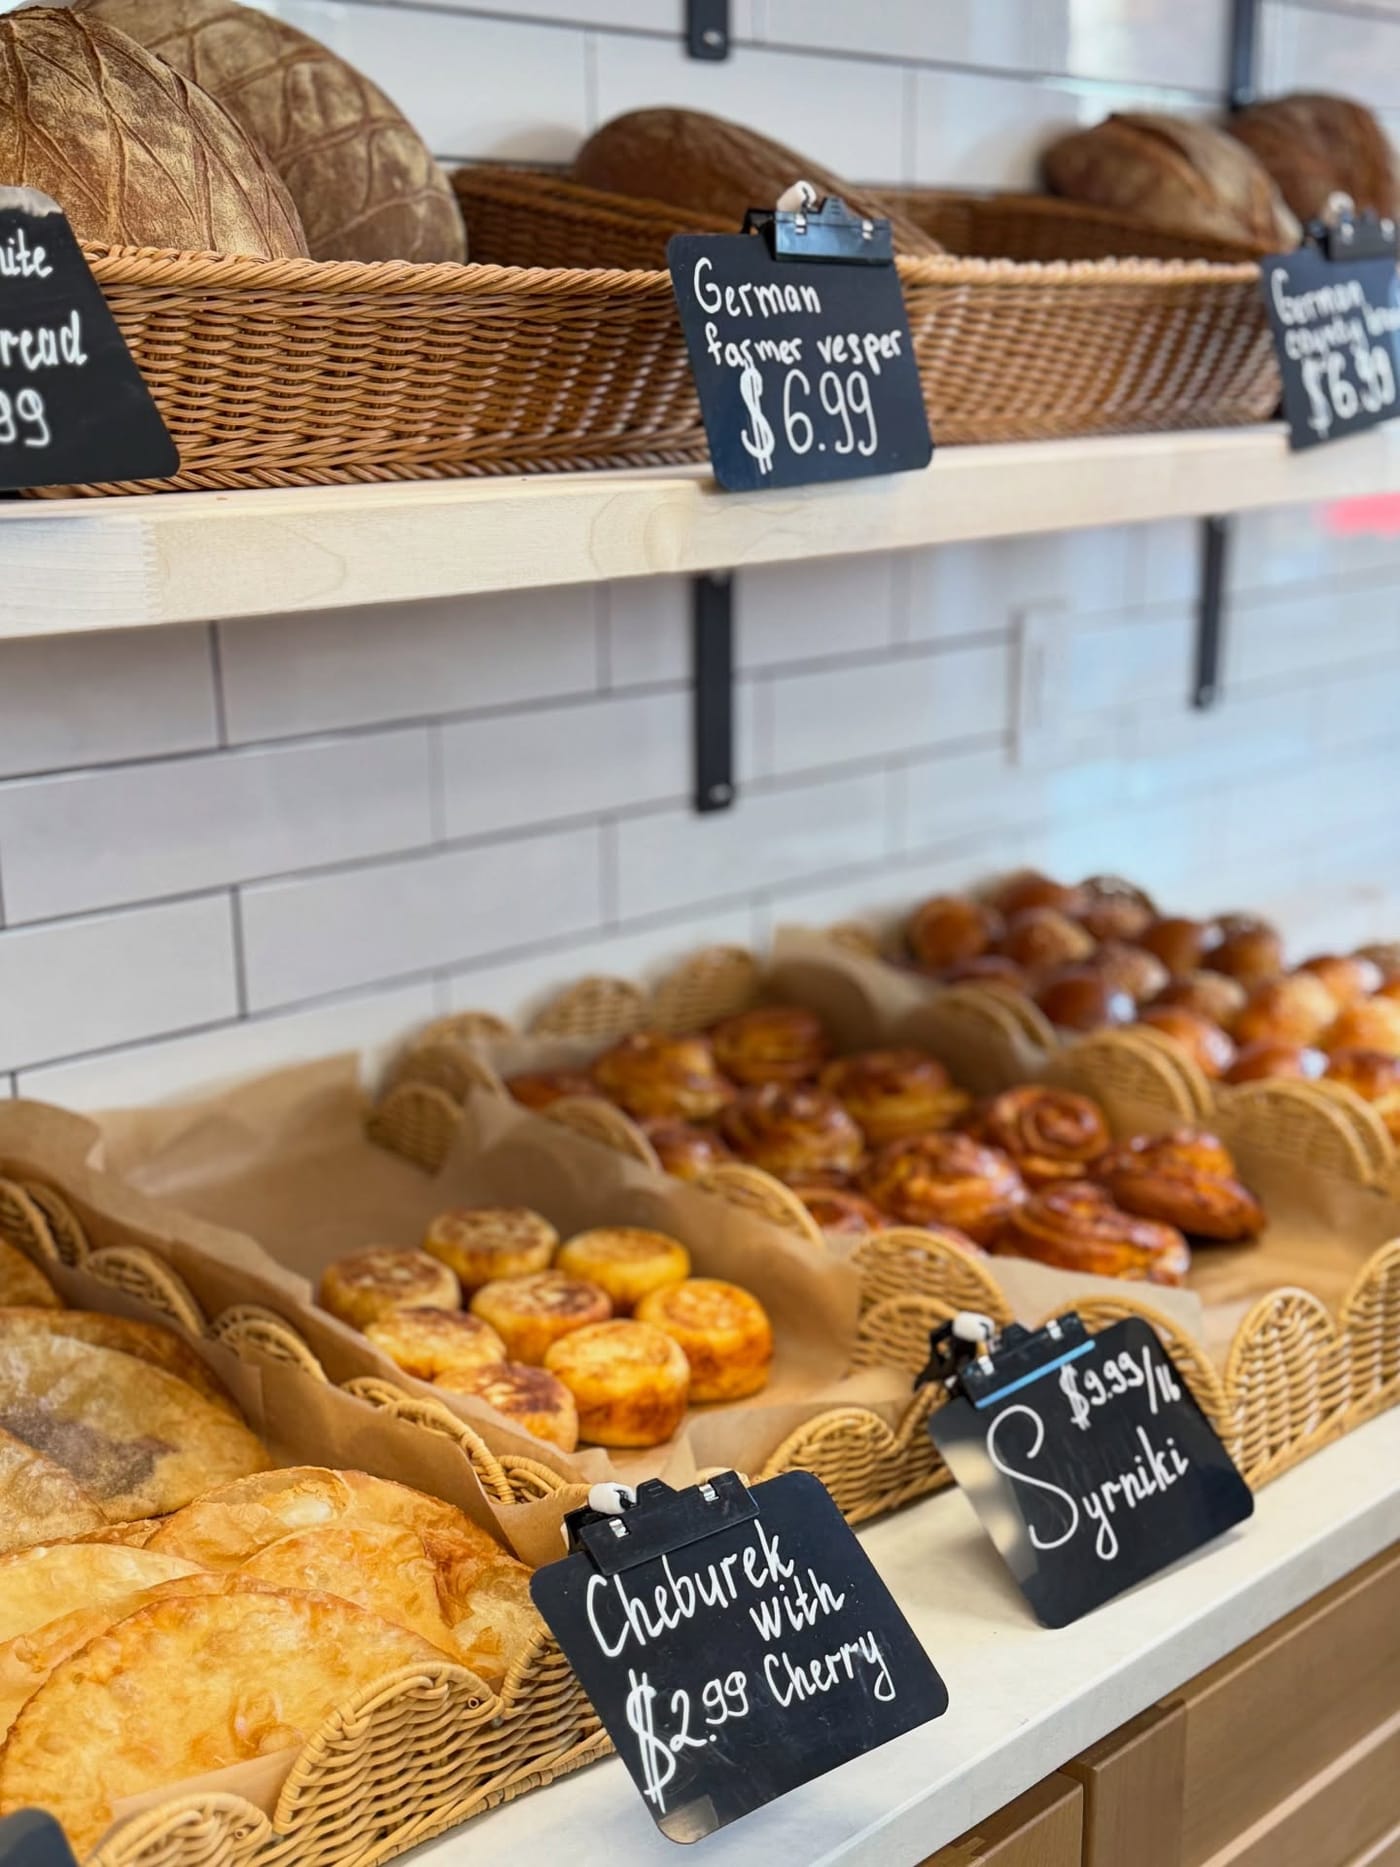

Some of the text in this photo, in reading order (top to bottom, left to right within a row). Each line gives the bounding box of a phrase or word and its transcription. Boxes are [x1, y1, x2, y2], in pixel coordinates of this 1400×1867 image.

[693, 256, 822, 318] German
[1271, 267, 1364, 326] German
[705, 321, 902, 376] farmer vesper
[739, 365, 878, 475] $6.99
[986, 1404, 1189, 1560] Syrniki
[586, 1519, 794, 1658] Cheburek
[749, 1568, 845, 1641] with
[763, 1631, 897, 1707] Cherry
[626, 1668, 749, 1813] $2.99
